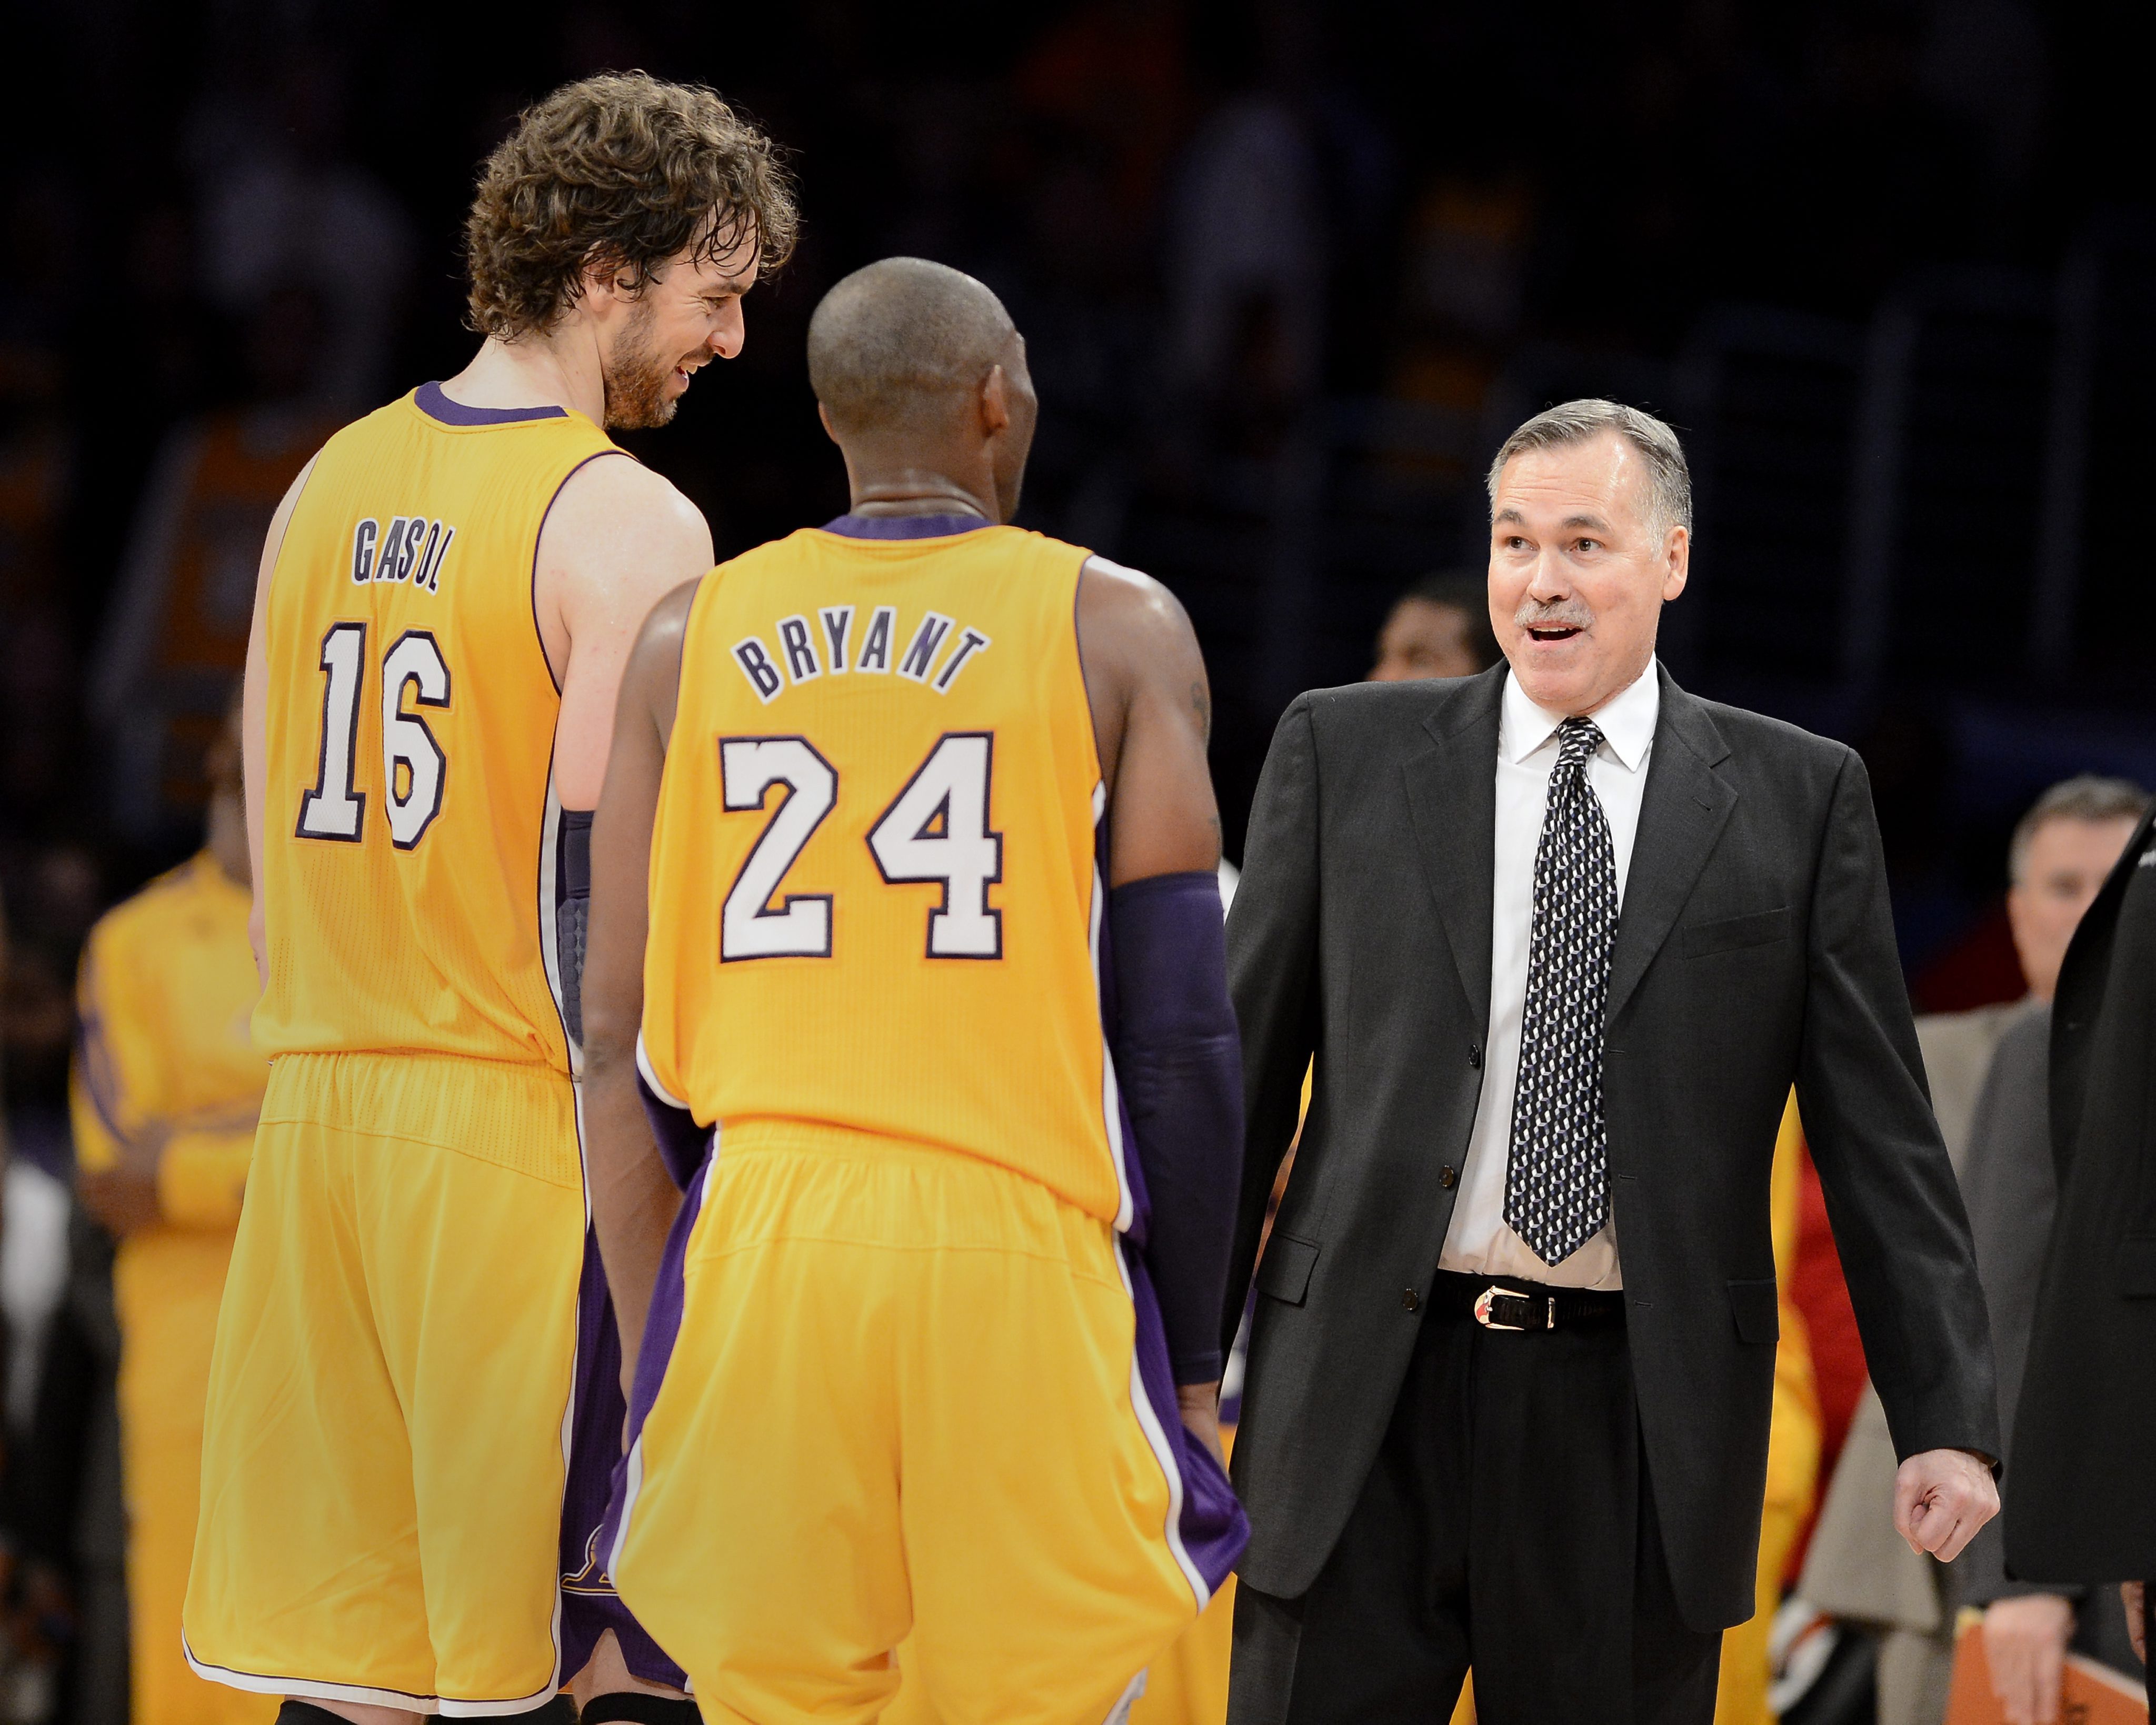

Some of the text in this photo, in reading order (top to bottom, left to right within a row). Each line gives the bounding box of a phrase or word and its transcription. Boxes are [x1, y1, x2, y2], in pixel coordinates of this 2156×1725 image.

[352, 516, 455, 595] GASOL
[295, 621, 451, 851] 16
[730, 605, 991, 705] BRYANT
[718, 731, 1003, 964] 24
